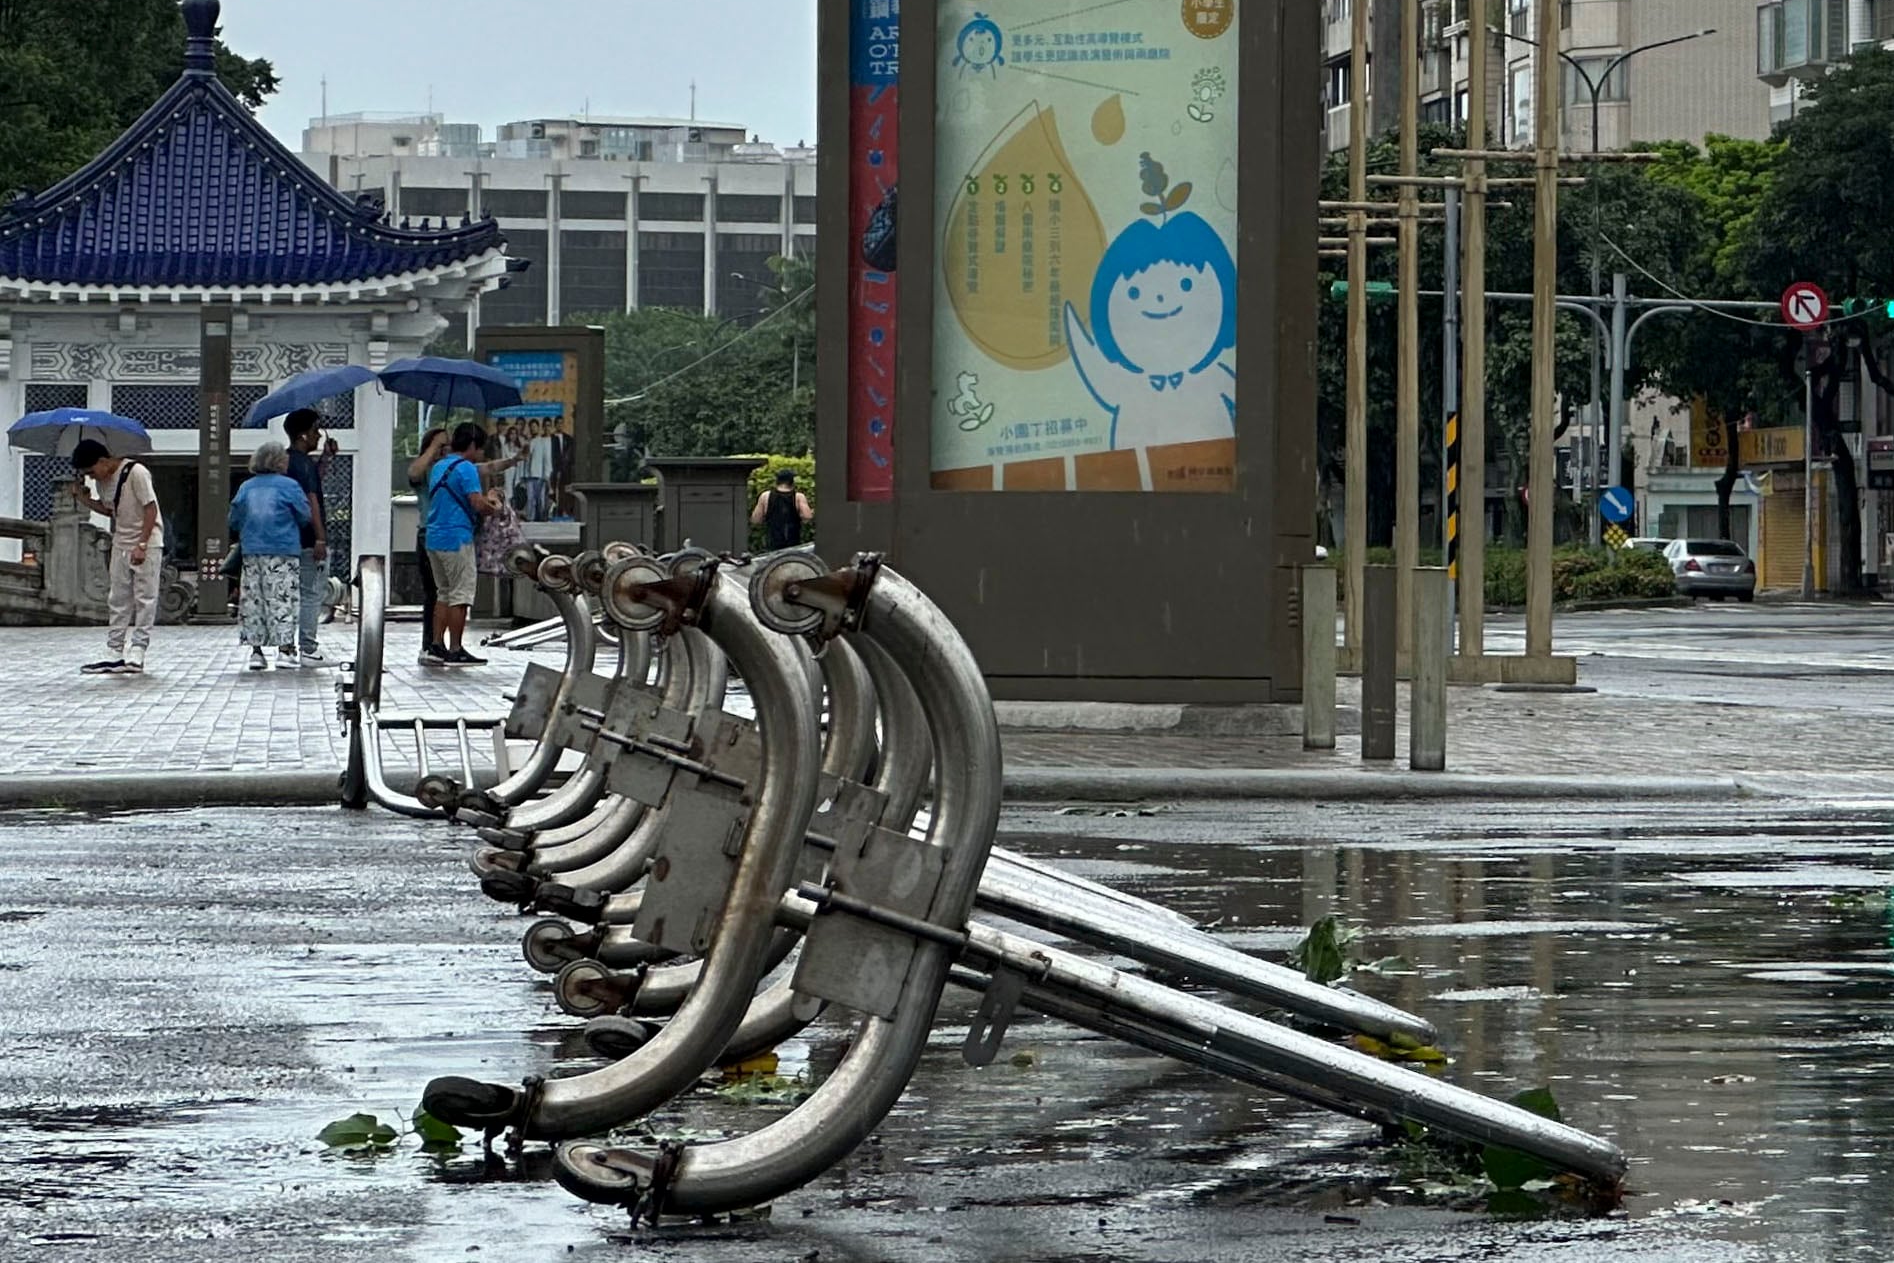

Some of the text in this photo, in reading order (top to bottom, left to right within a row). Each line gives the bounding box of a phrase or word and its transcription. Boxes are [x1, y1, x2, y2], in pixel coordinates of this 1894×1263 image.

[1000, 418, 1087, 440] 小園丁招募中
